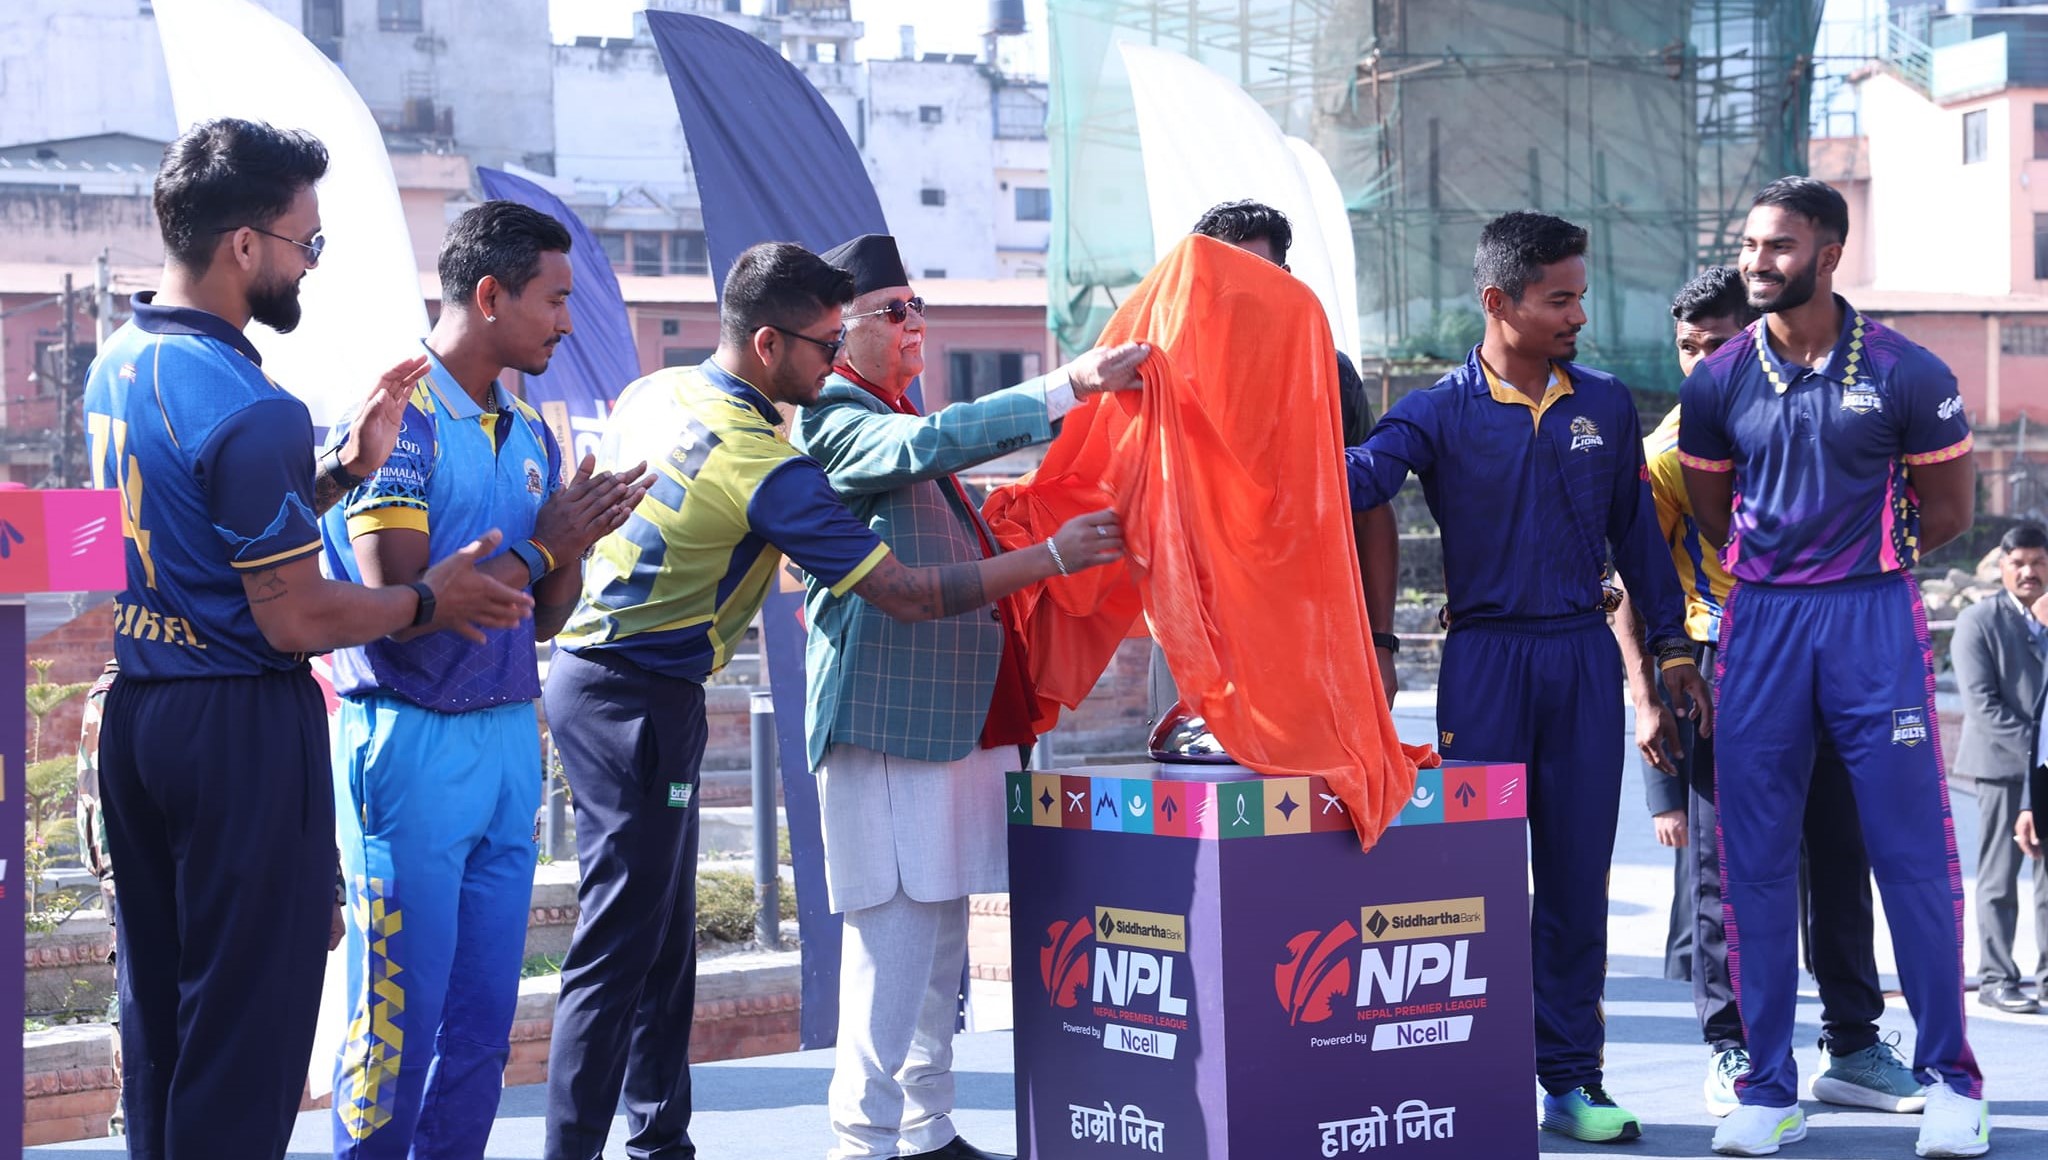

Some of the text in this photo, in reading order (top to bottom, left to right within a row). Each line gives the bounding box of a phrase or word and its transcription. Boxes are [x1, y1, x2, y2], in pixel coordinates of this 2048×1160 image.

[396, 435, 420, 455] ton
[1892, 726, 1927, 741] BOLTS
[1092, 947, 1187, 1016] NPL
[1356, 939, 1488, 1007] NPL
[1093, 1006, 1188, 1030] NEPAL PREMIER LEAGUE
[1357, 998, 1488, 1021] NEPAL PREMIER LEAGUE
[1063, 1021, 1159, 1054] Powered by Ncell
[1311, 1020, 1449, 1047] Powered by Ncell
[1069, 1101, 1165, 1153] हाम्रो जित
[1318, 1099, 1456, 1158] हाम्रो जित
